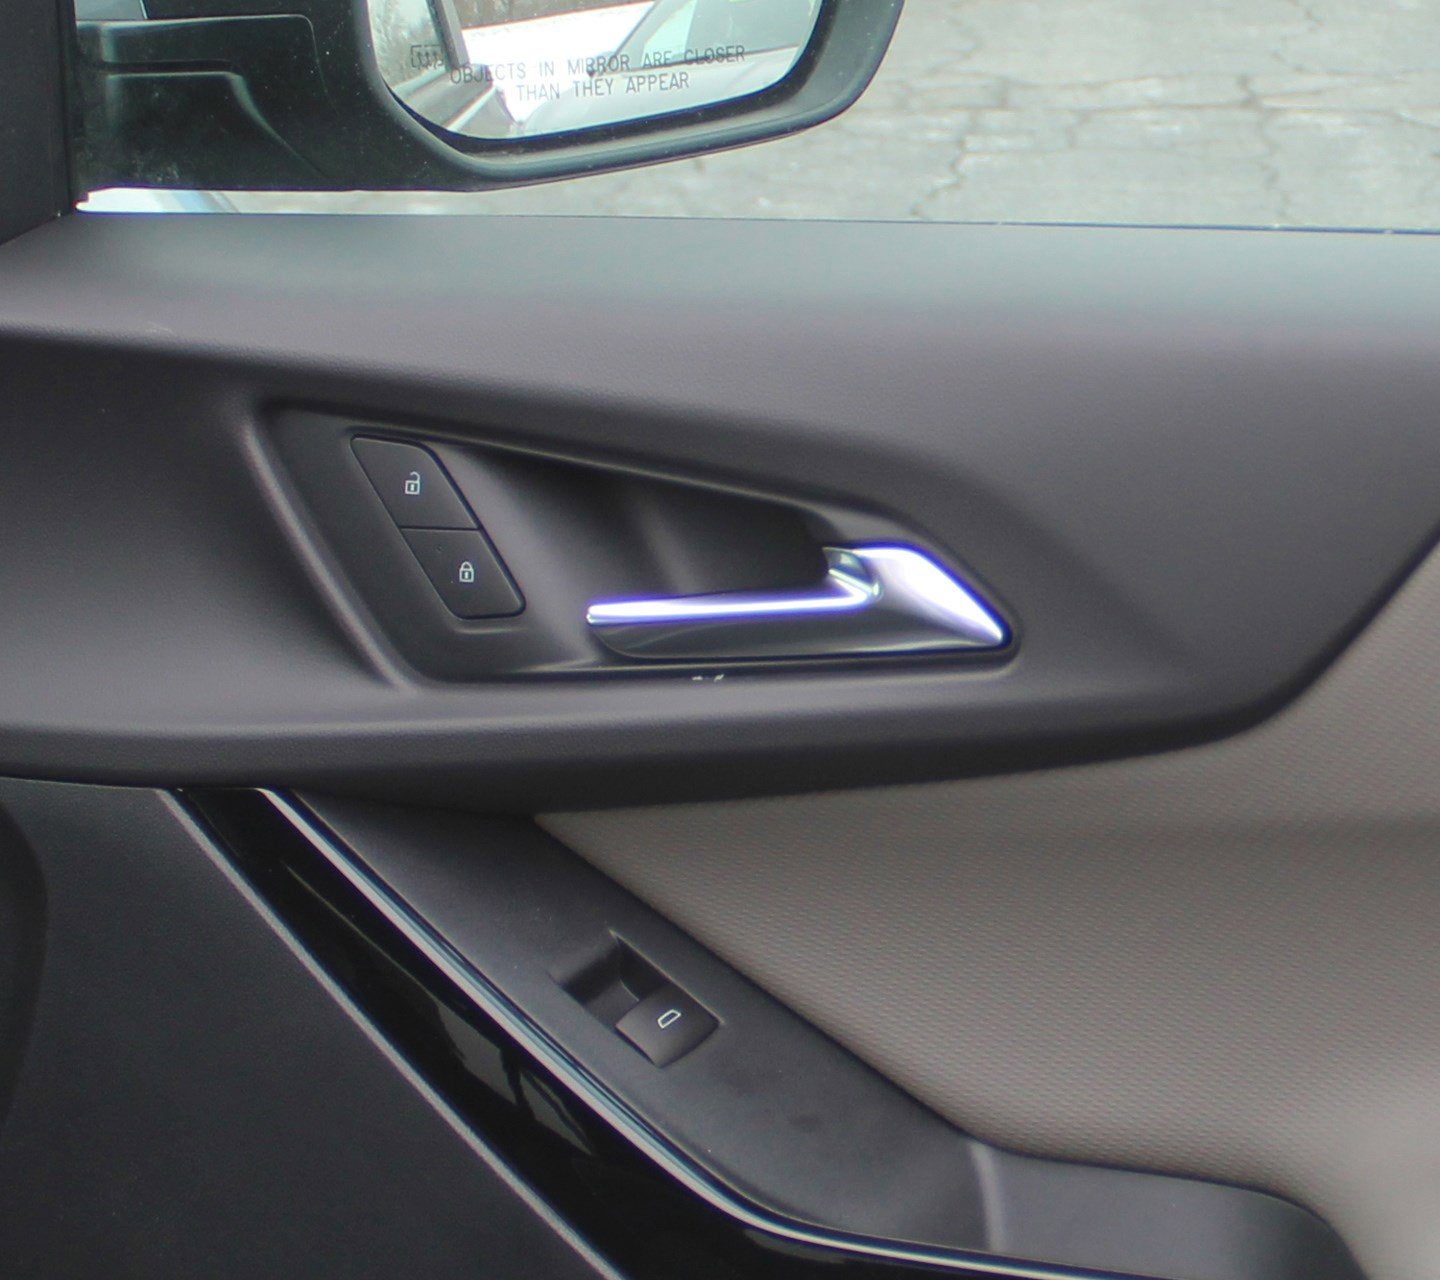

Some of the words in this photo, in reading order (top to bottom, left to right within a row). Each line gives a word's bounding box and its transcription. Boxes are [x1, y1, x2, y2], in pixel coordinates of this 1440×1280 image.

[450, 63, 526, 85] OBJECTS
[539, 61, 555, 77] IN
[568, 55, 631, 76] MIRROR
[642, 49, 672, 69] ARE
[684, 45, 746, 65] CLOSER
[518, 83, 561, 101] THAN
[573, 78, 614, 98] THEY
[626, 72, 690, 93] APPEAR
